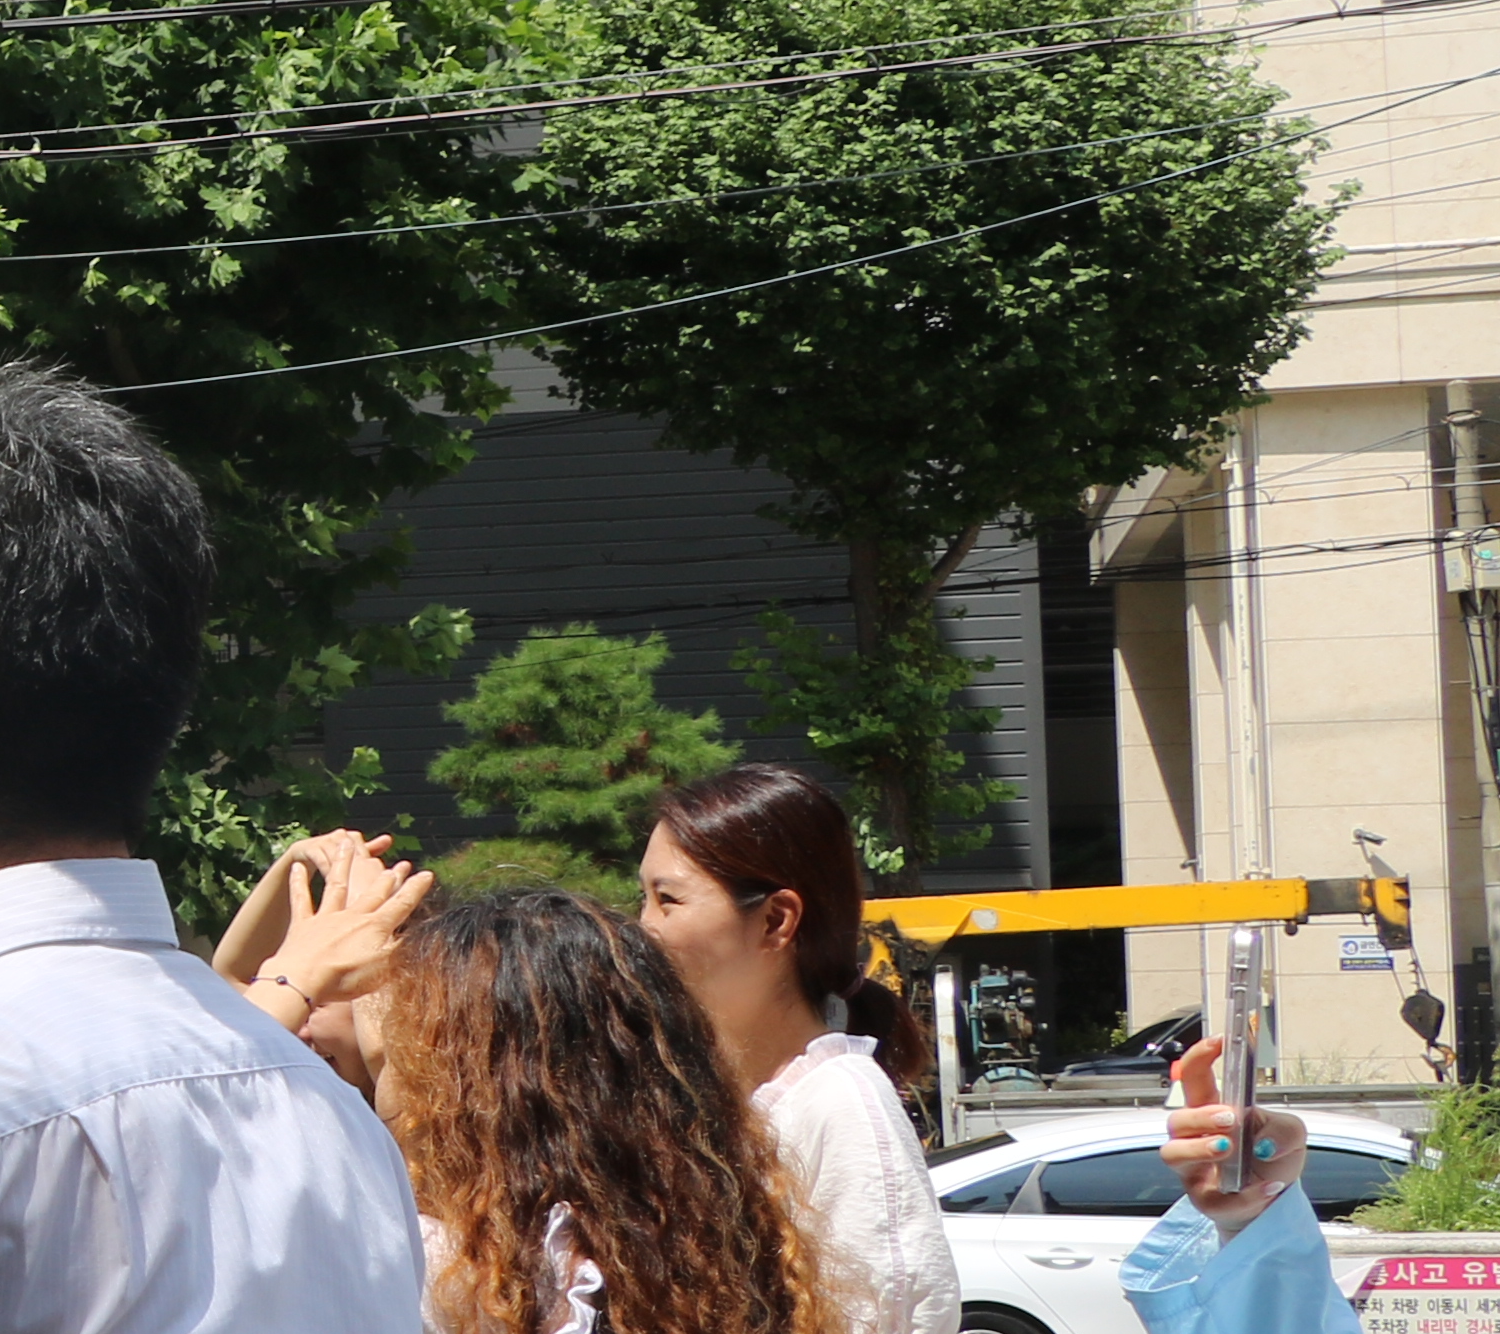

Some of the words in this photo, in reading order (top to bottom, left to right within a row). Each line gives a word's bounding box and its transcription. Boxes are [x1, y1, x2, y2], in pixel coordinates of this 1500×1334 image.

[1391, 1298, 1419, 1315] 차량
[1427, 1297, 1469, 1315] 이동시
[1368, 1318, 1409, 1334] 주차장
[1416, 1318, 1458, 1334] 내리막
